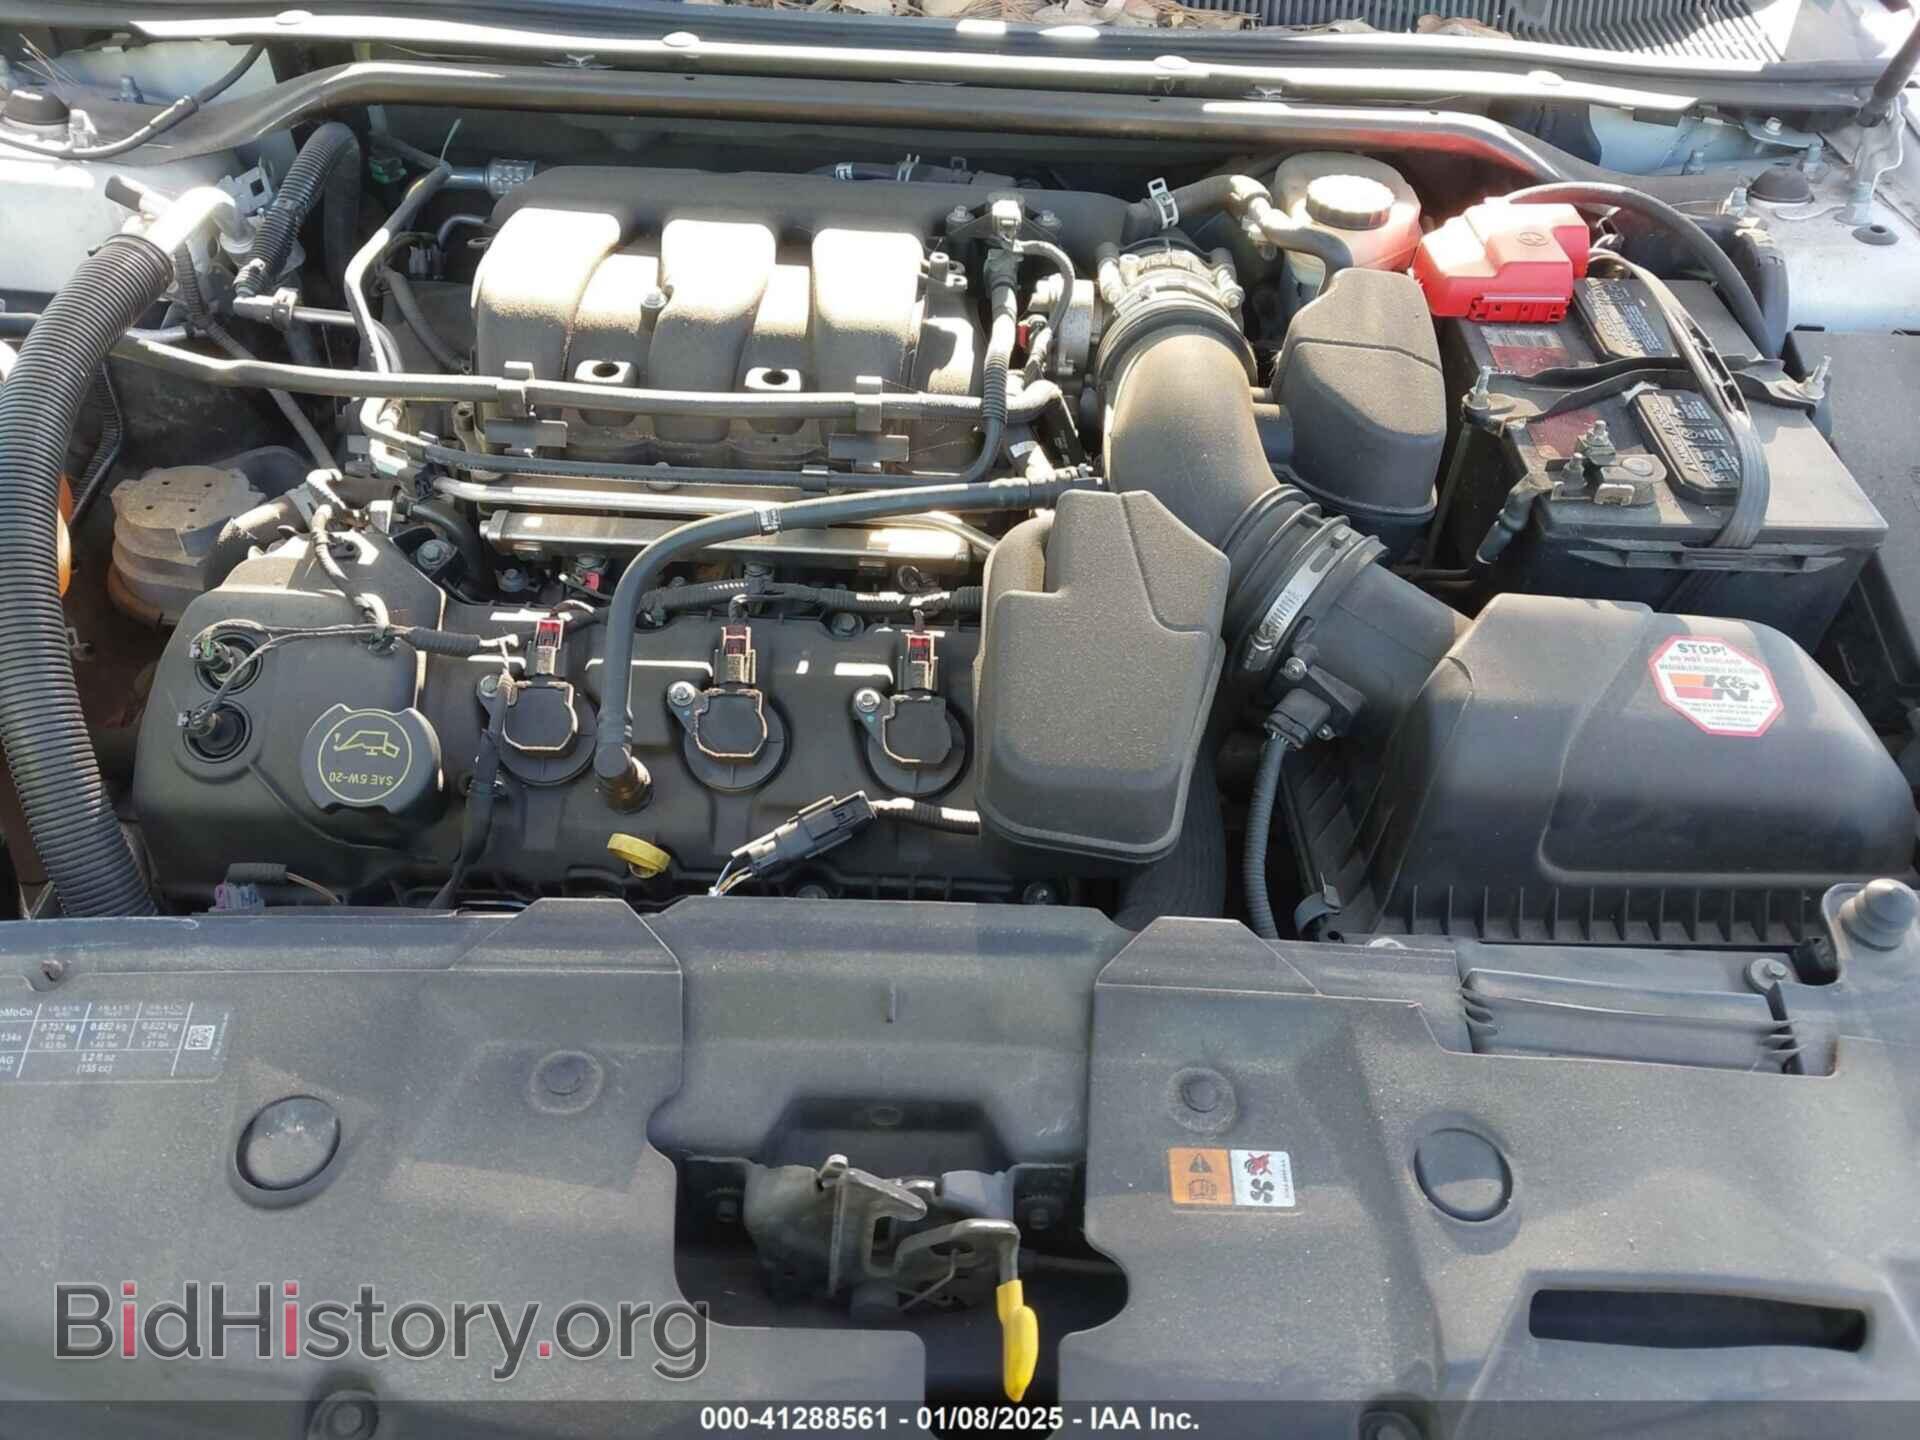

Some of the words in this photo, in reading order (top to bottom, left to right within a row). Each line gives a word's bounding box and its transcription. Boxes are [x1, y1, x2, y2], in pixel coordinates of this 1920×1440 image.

[1677, 643, 1727, 656] STOP!
[329, 771, 368, 785] 5W-20
[370, 774, 394, 786] SAE
